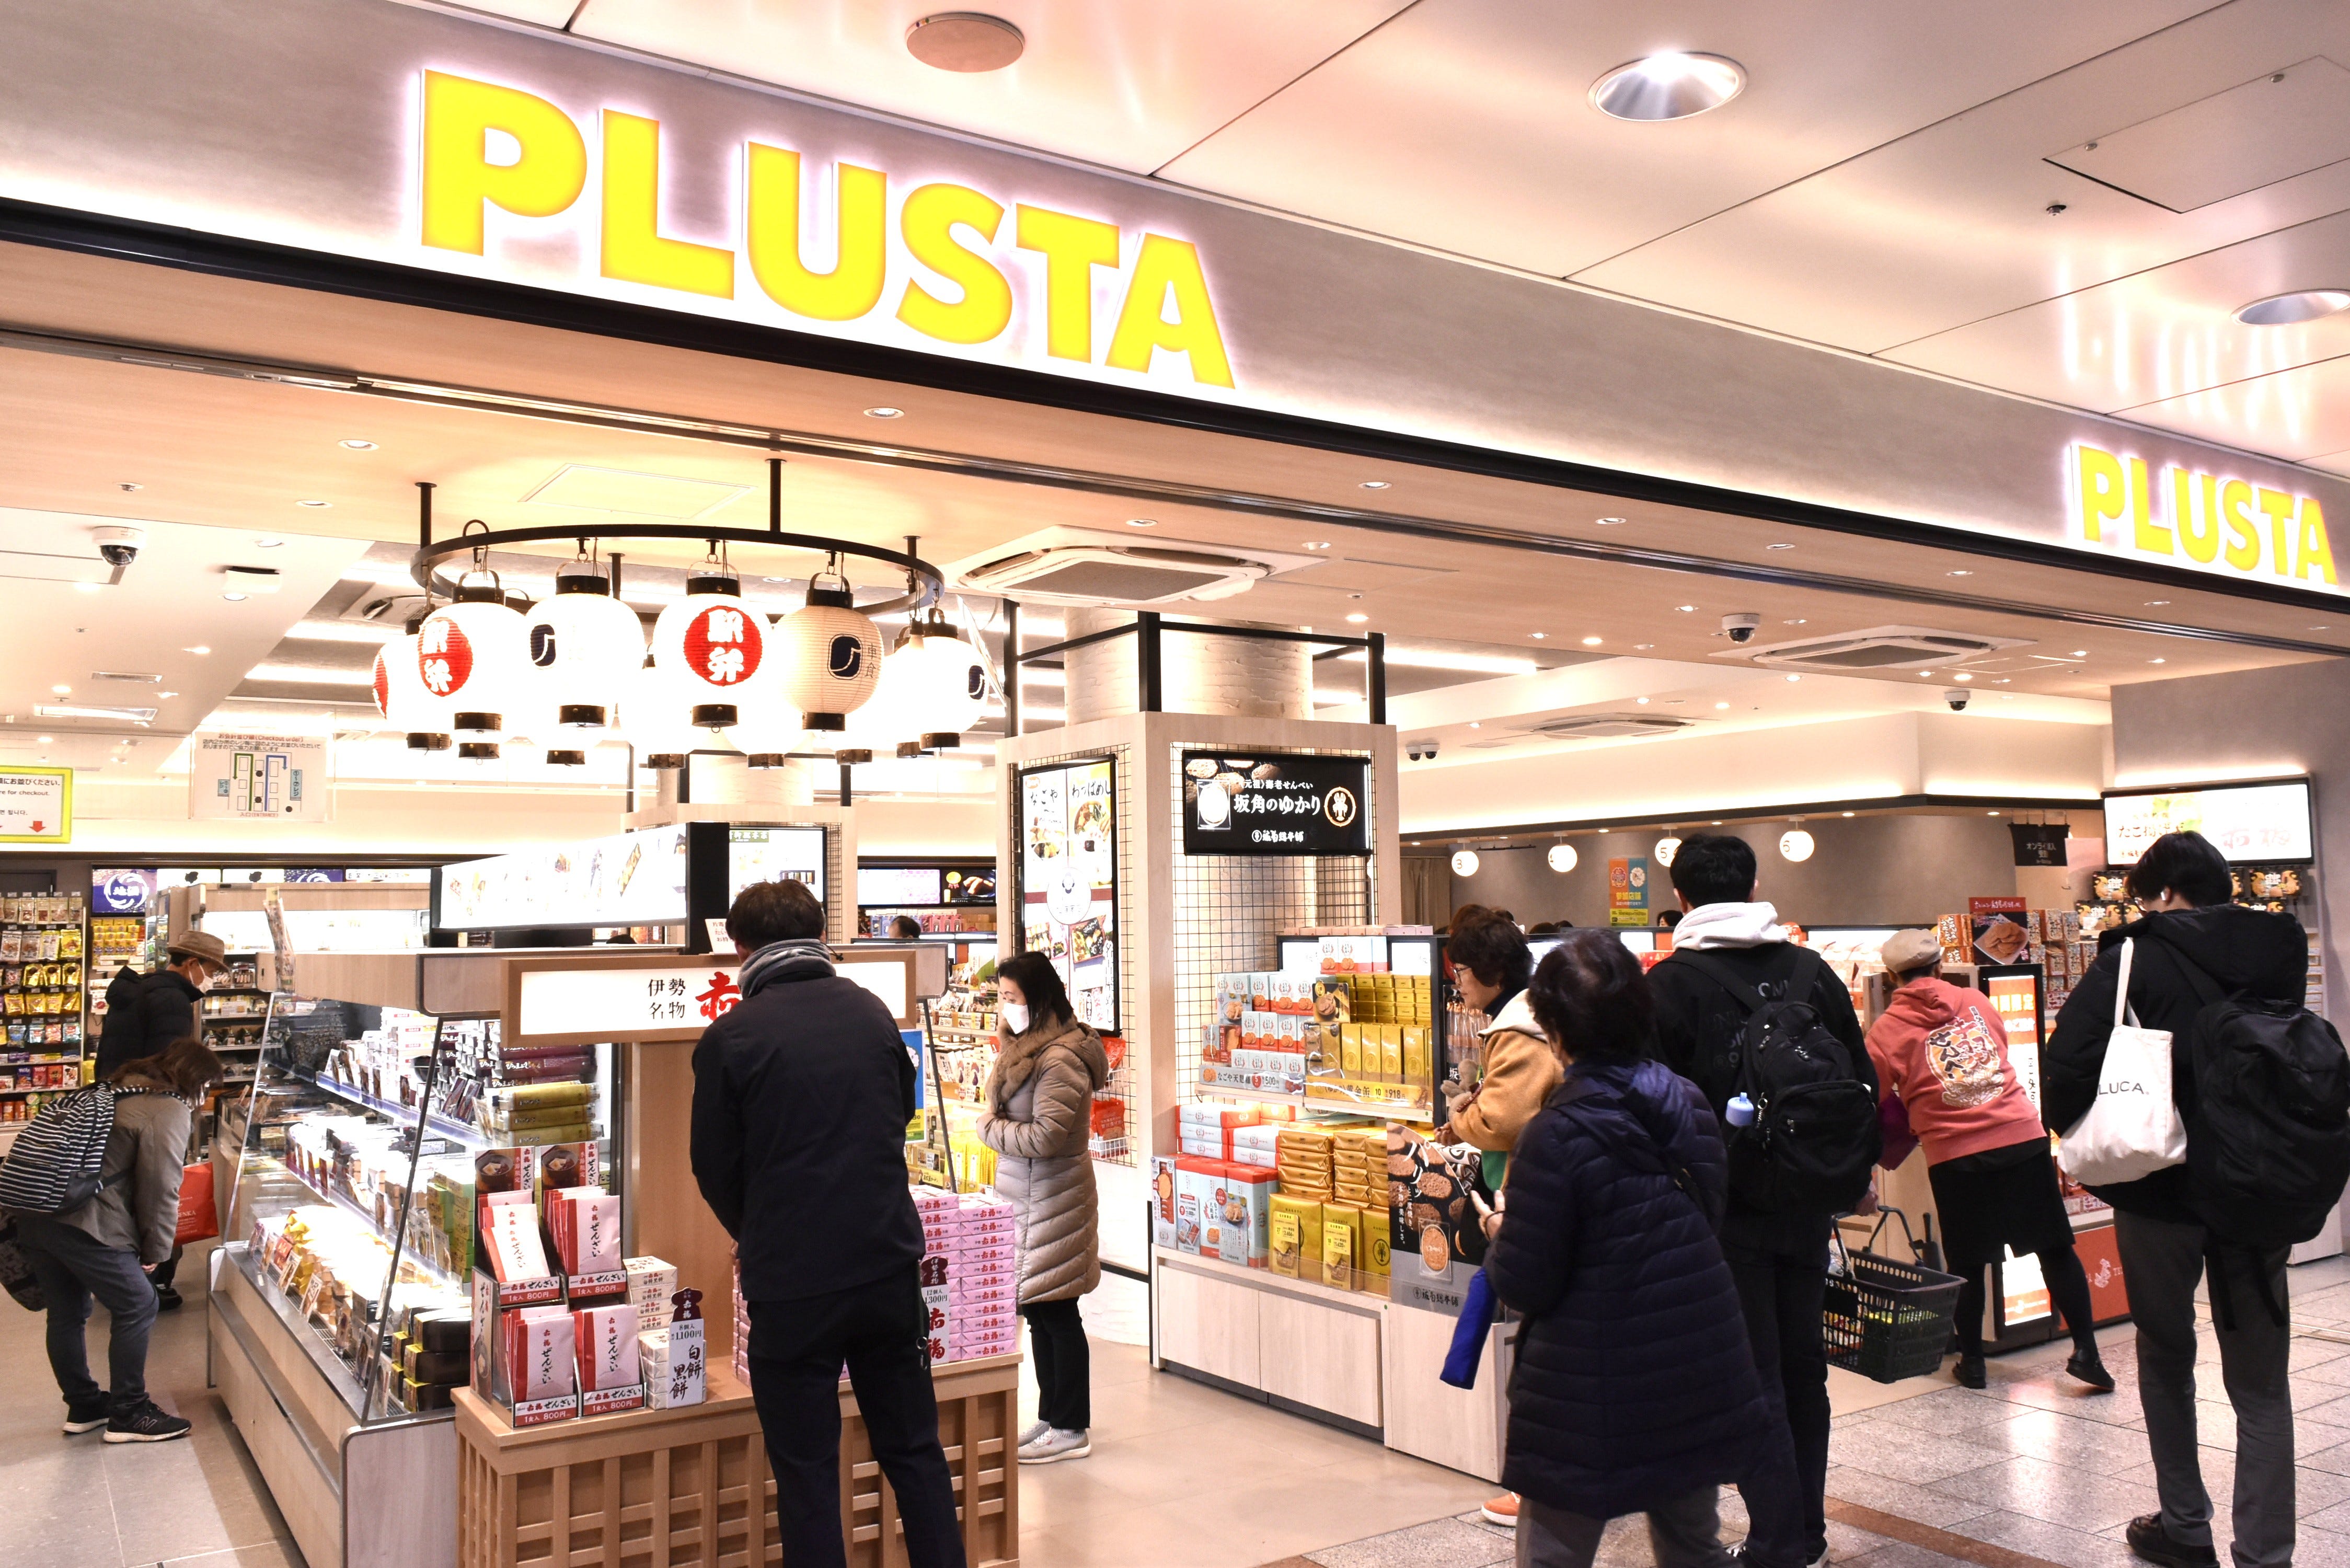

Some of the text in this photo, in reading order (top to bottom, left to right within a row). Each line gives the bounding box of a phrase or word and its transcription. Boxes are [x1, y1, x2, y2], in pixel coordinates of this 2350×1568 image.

[421, 69, 1235, 389] PLUSTA
[2079, 445, 2339, 585] PLUSTA
[1234, 794, 1321, 815] 坂角のゆかり
[1660, 847, 1667, 859] 5
[1783, 840, 1790, 852] 6
[1457, 859, 1462, 869] 3
[648, 978, 685, 996] 伊勢
[649, 1002, 685, 1019] 名物
[2099, 1081, 2144, 1096] LUCA
[590, 1204, 601, 1258] 赤福ぜんざい
[510, 1279, 558, 1292] 赤福ぜんざい
[579, 1273, 625, 1285] 赤福ぜんざい
[509, 1291, 549, 1302] 1食入 800円
[578, 1286, 592, 1295] 1食入
[683, 1300, 692, 1319] 赤福
[928, 1308, 945, 1359] 赤福
[607, 1316, 618, 1373] 赤福ぜんざい
[540, 1329, 552, 1385] 赤福ぜんざい
[686, 1344, 703, 1379] 白餅
[670, 1365, 688, 1400] 黒餅
[594, 1388, 641, 1401] 赤福ぜんざい
[526, 1398, 576, 1412] 赤福ぜんざい
[592, 1400, 632, 1412] 1食入 800円
[524, 1411, 566, 1424] 1食入 800円
